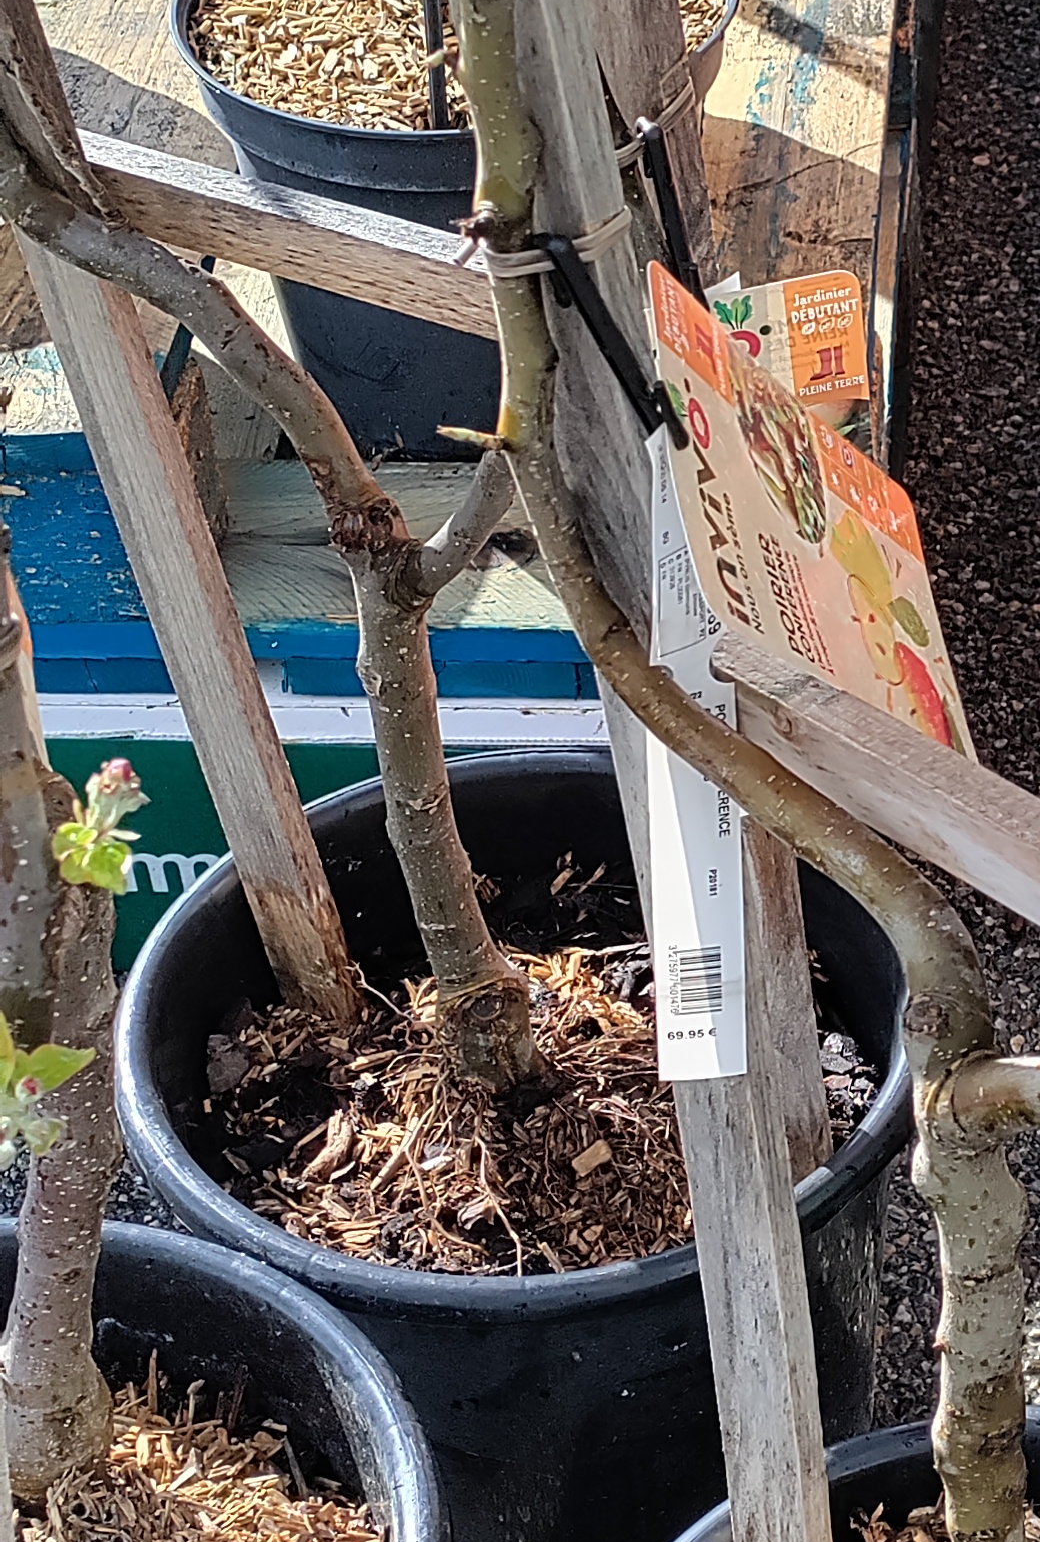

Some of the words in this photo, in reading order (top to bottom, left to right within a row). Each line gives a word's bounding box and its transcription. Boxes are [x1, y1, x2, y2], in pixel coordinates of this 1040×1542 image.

[793, 287, 852, 307] Jardinier
[791, 298, 859, 324] DÉBUTANT
[799, 382, 832, 397] PLEINE
[834, 375, 865, 389] TERRE
[736, 553, 748, 580] on
[758, 532, 804, 657] POIRIER
[744, 584, 765, 635] Nous
[717, 789, 731, 838] ERENCE
[667, 1029, 705, 1041] 69.95
